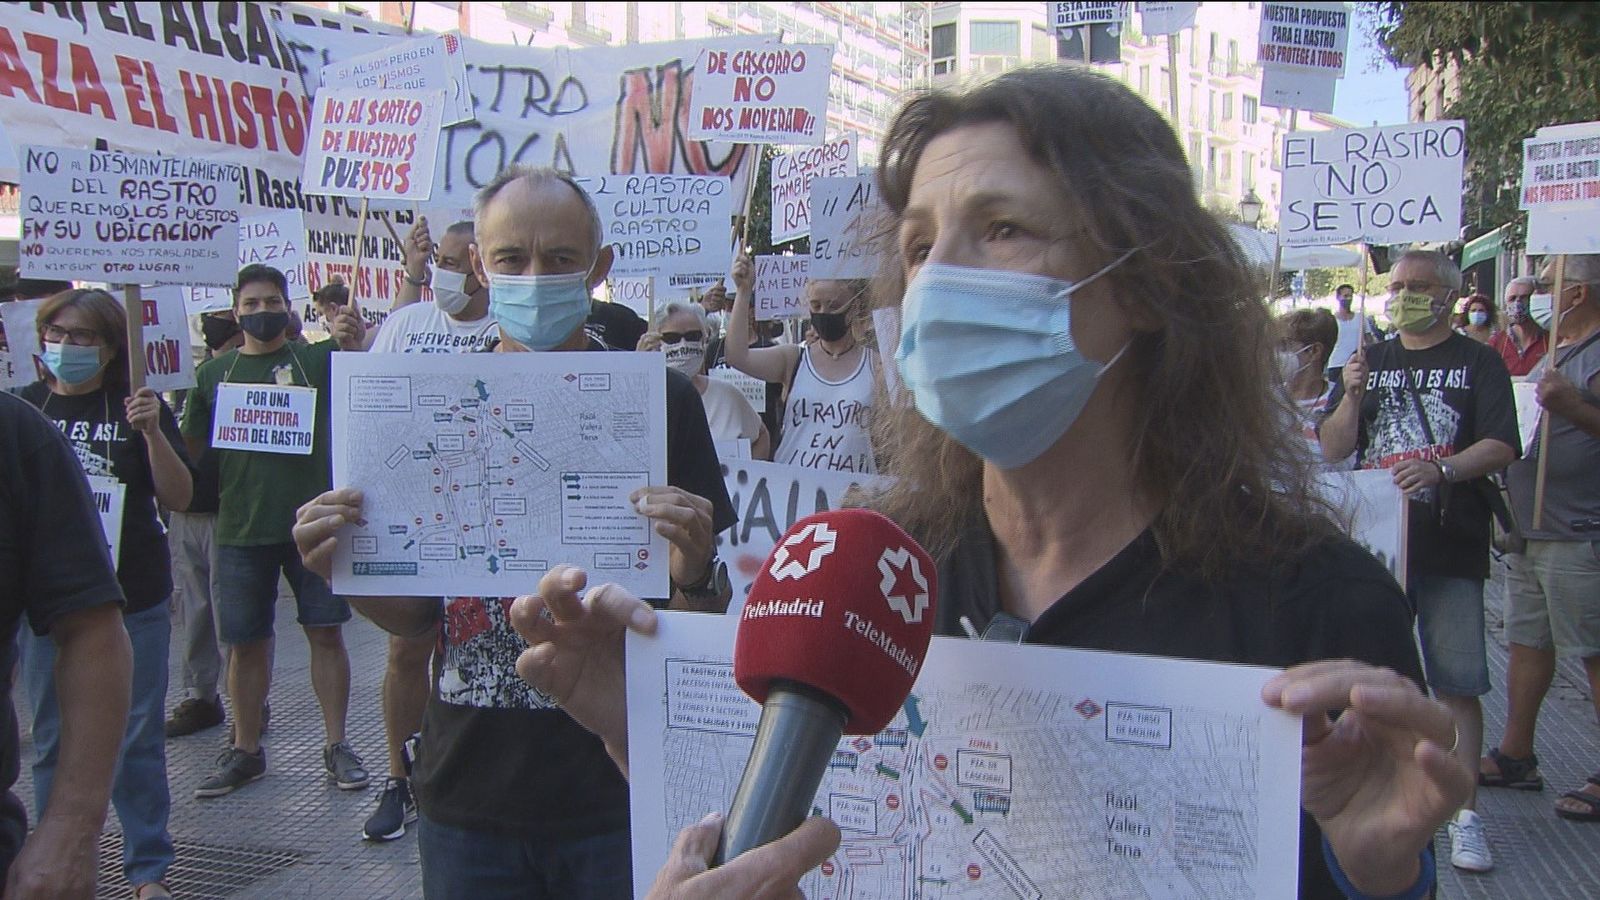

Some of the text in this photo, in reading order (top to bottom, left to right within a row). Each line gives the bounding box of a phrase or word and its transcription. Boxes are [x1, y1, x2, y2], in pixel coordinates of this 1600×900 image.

[1058, 9, 1113, 24] DEL VIRUS
[1263, 4, 1347, 29] NUESTRA PROPUESTA
[1272, 25, 1336, 49] PARA EL RASTRO
[353, 66, 366, 76] AL
[389, 52, 417, 65] PERO
[420, 46, 435, 57] EN
[706, 50, 806, 76] DE CASCORRO
[1260, 44, 1343, 69] NOS PROTEGE A TODOS
[356, 77, 377, 90] LOS
[378, 64, 421, 86] MISMOS
[733, 76, 776, 102] NO
[114, 54, 179, 134] EL
[179, 69, 311, 157] HISTÓ
[324, 97, 423, 127] NO AL SORTEO
[701, 107, 734, 131] NOS
[321, 130, 417, 161] DE NUESTROS
[1285, 125, 1464, 169] EL RASTRO
[26, 147, 60, 174] NO
[89, 151, 240, 182] DESMANTELAMIENTO
[777, 139, 850, 180] CASCORRO
[321, 156, 412, 195] PUESTOS
[626, 177, 725, 198] RASTRO
[1327, 161, 1389, 196] NO
[72, 177, 216, 206] DEL RASTRO
[28, 195, 240, 223] QUEREMOS LOS PUESTOS
[613, 200, 711, 218] CULTURA
[1288, 195, 1443, 233] SE TOCA
[22, 217, 47, 241] EN
[54, 218, 82, 240] SU
[610, 219, 698, 236] RASTRO
[47, 246, 113, 257] QUEREMOS
[121, 248, 145, 258] NOS
[308, 229, 379, 260] REAPERTRA
[611, 236, 702, 260] MADRID
[814, 238, 832, 260] EL
[103, 262, 134, 273] OTRO
[138, 263, 180, 274] LUGAR
[760, 297, 779, 310] EL
[425, 332, 452, 346] FIVE
[1426, 368, 1443, 388] ES
[246, 391, 290, 408] POR UNA
[233, 408, 299, 428] REAPERTURA
[792, 397, 872, 429] EL RASTRO
[70, 421, 90, 441] ES
[216, 426, 312, 448] JUSTA DEL RASTRO
[810, 433, 844, 450] EN
[743, 598, 825, 621] TeleMadrid
[844, 610, 920, 678] TeleMadrid
[1105, 791, 1138, 811] Raúl
[1105, 815, 1152, 838] Valera
[1106, 839, 1142, 860] Tena
